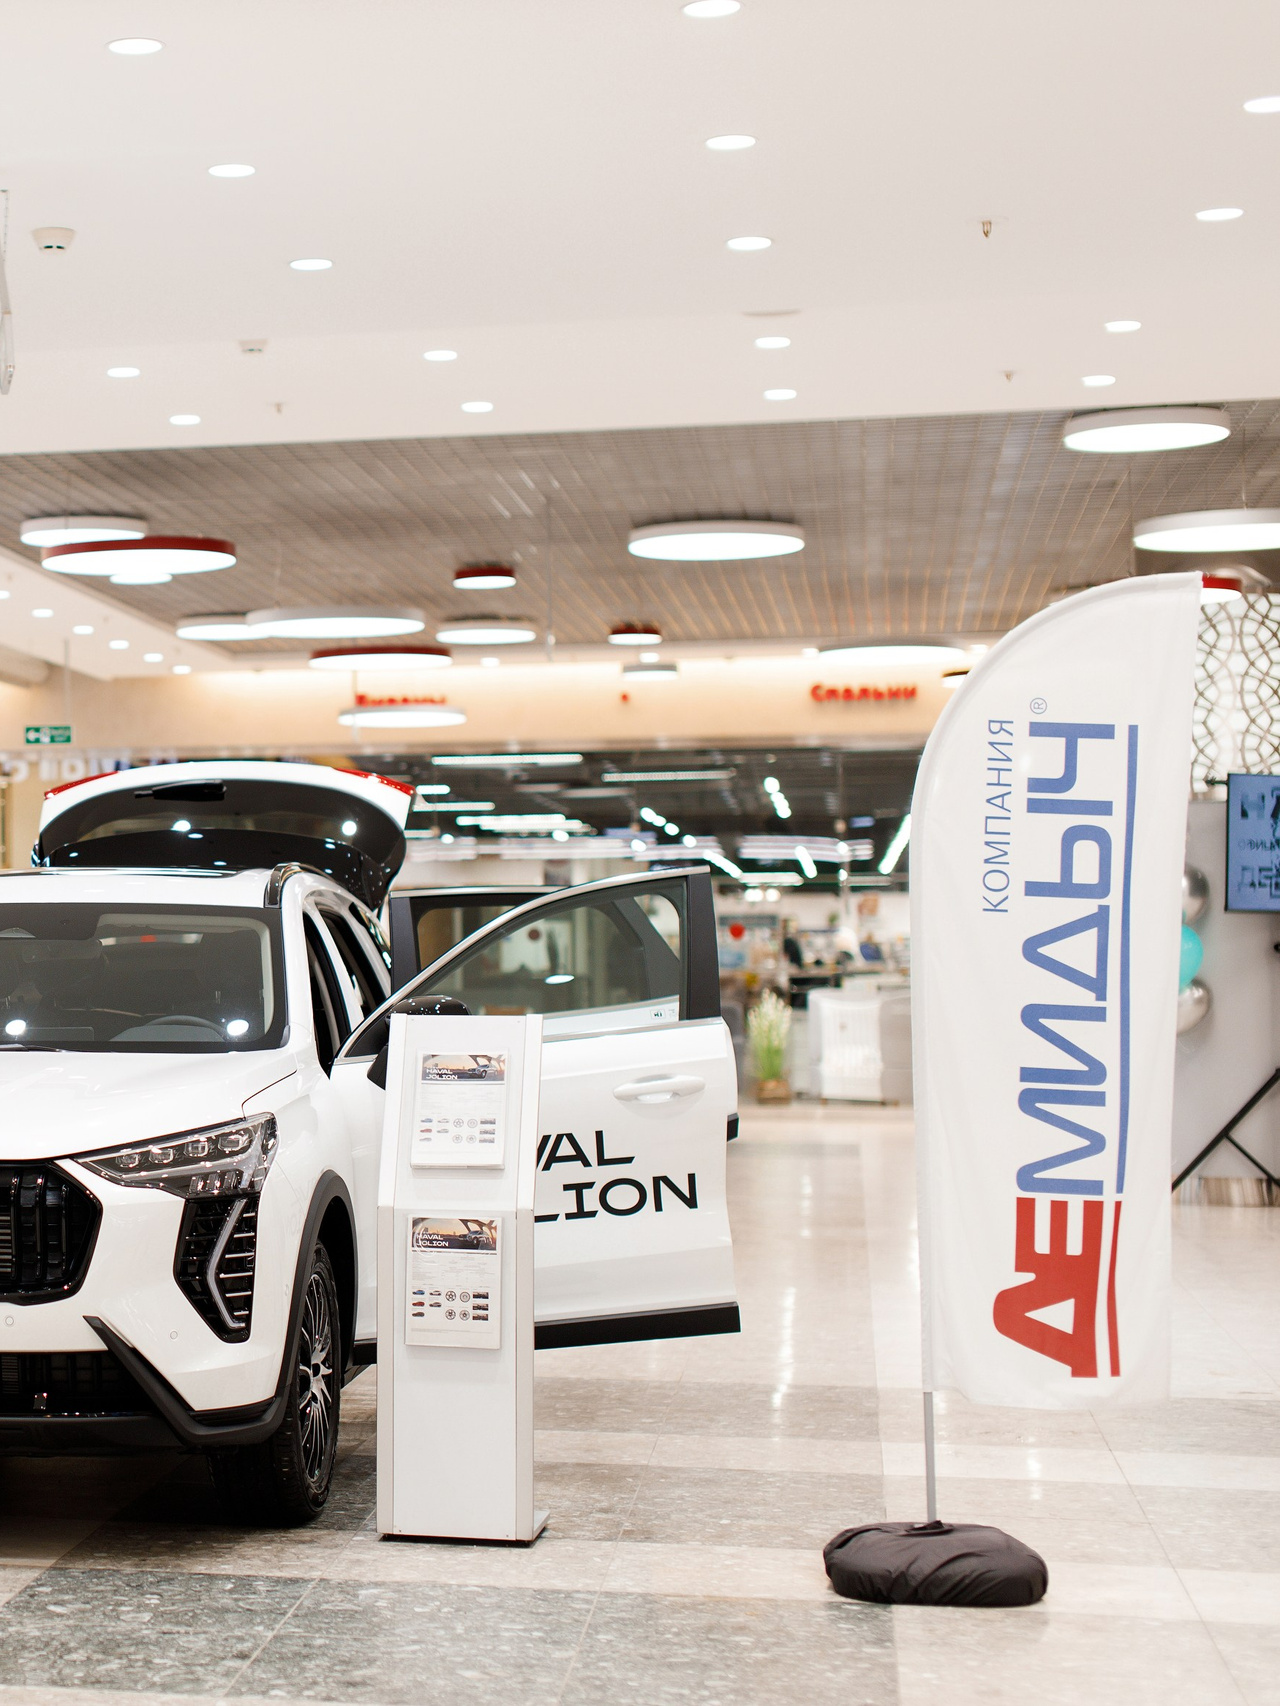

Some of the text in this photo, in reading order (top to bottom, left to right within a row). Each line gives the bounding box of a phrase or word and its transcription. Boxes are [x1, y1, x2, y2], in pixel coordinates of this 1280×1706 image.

[811, 684, 917, 702] Спальни
[982, 719, 1014, 913] КОМПАНИЯ
[992, 721, 1116, 1379] ДЕМИДЫЧ
